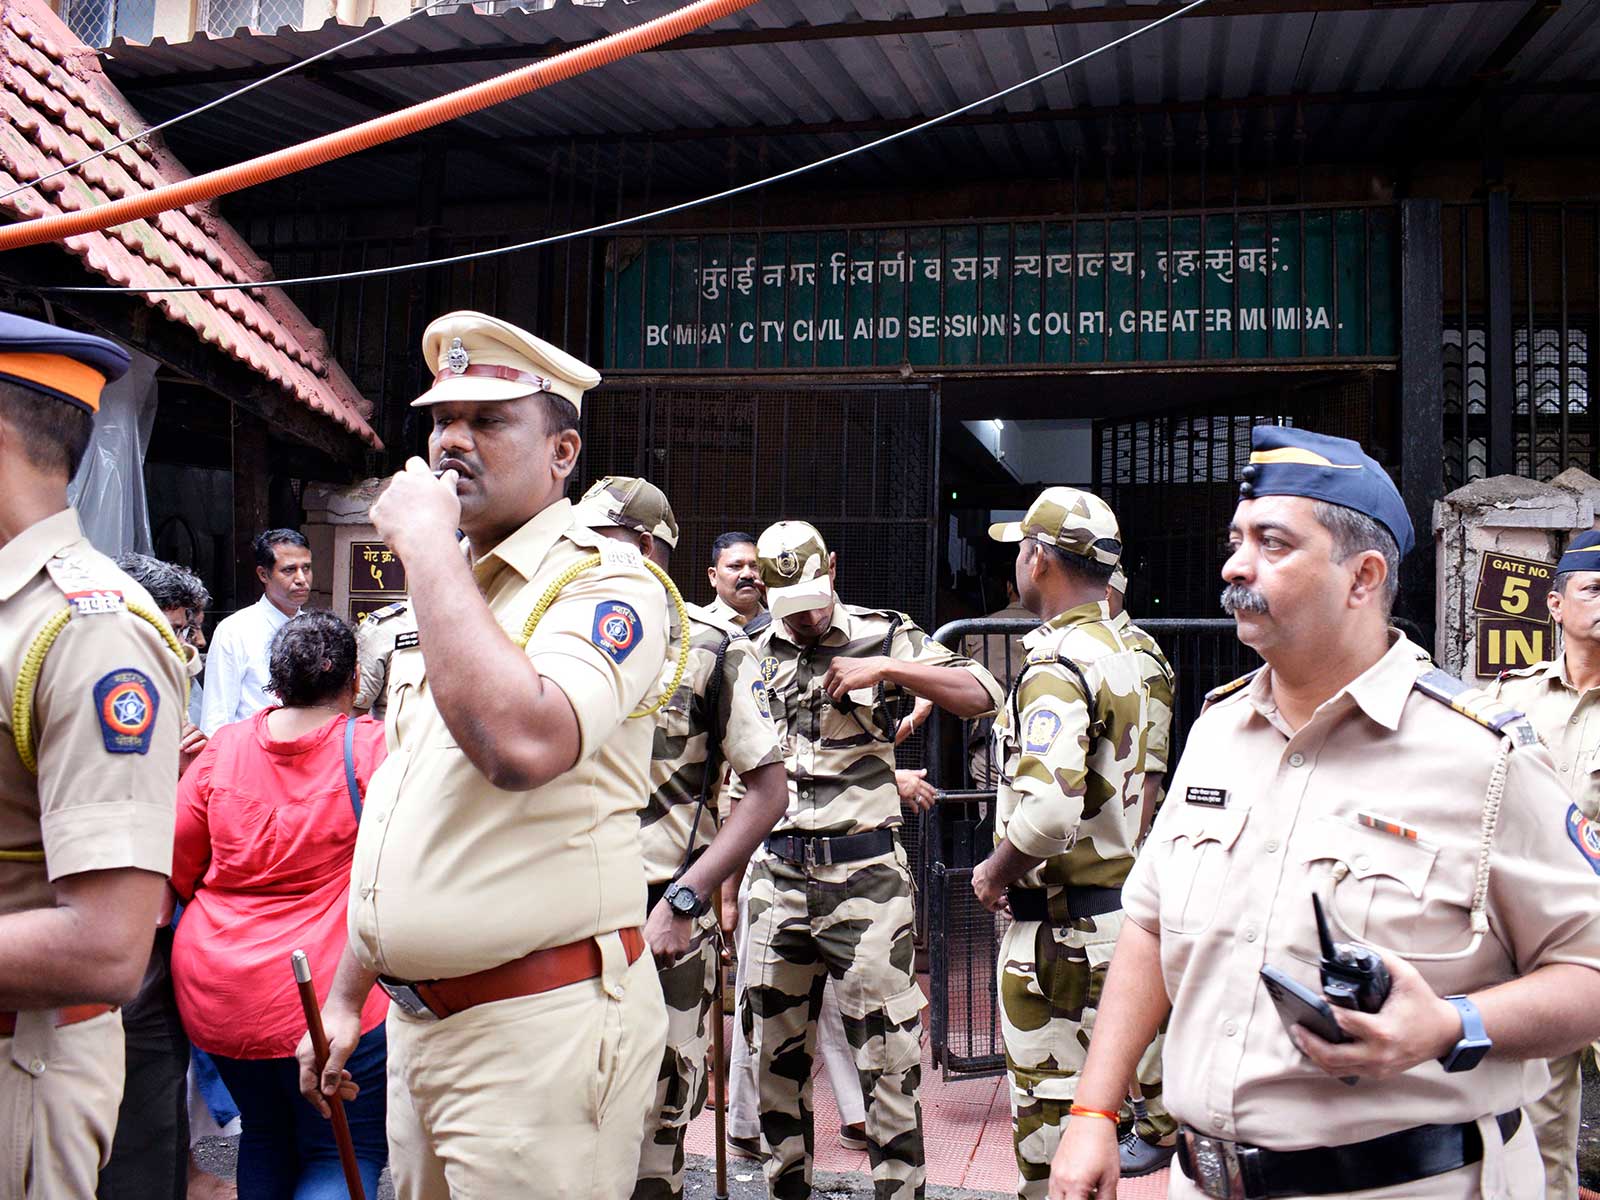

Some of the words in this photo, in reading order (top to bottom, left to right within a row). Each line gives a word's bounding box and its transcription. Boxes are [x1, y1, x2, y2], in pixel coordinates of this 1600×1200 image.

[740, 321, 785, 343] CTY
[793, 319, 844, 342] CIVIL
[853, 318, 900, 339] AND
[908, 313, 1021, 338] SESSIONS
[1028, 311, 1113, 337] COURT,
[1119, 309, 1232, 333] GREATER
[1239, 307, 1343, 331] MUMBA.
[363, 546, 379, 562] गेट
[1492, 559, 1525, 575] GATE
[1528, 566, 1550, 579] NO.
[1500, 575, 1532, 614] 5
[1488, 630, 1543, 665] IN
